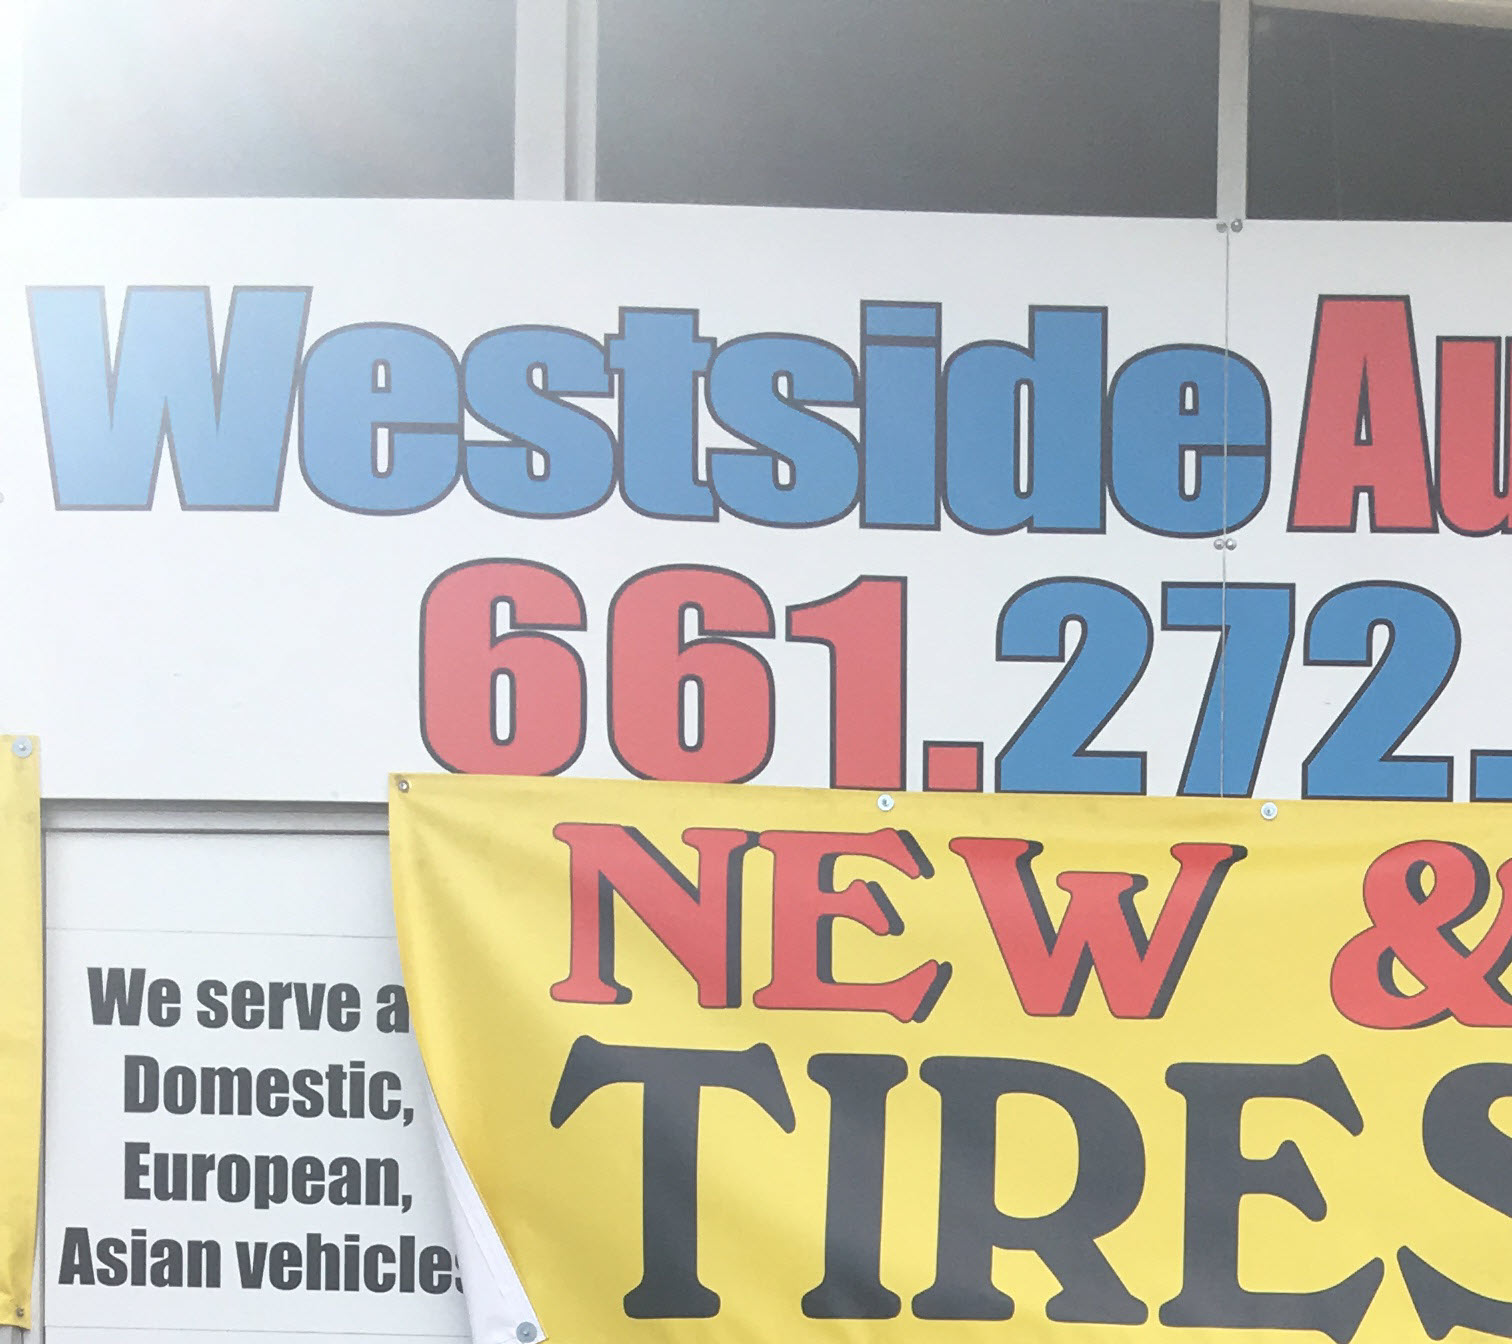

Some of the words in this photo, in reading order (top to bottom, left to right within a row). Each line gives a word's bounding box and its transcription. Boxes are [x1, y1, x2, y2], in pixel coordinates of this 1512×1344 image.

[25, 284, 1273, 536] Westside
[549, 822, 1247, 1023] NEW
[86, 966, 182, 1029] We
[196, 979, 362, 1033] serve
[124, 1054, 416, 1128] Domestic,
[124, 1141, 414, 1214] European,
[57, 1227, 222, 1290] Asian
